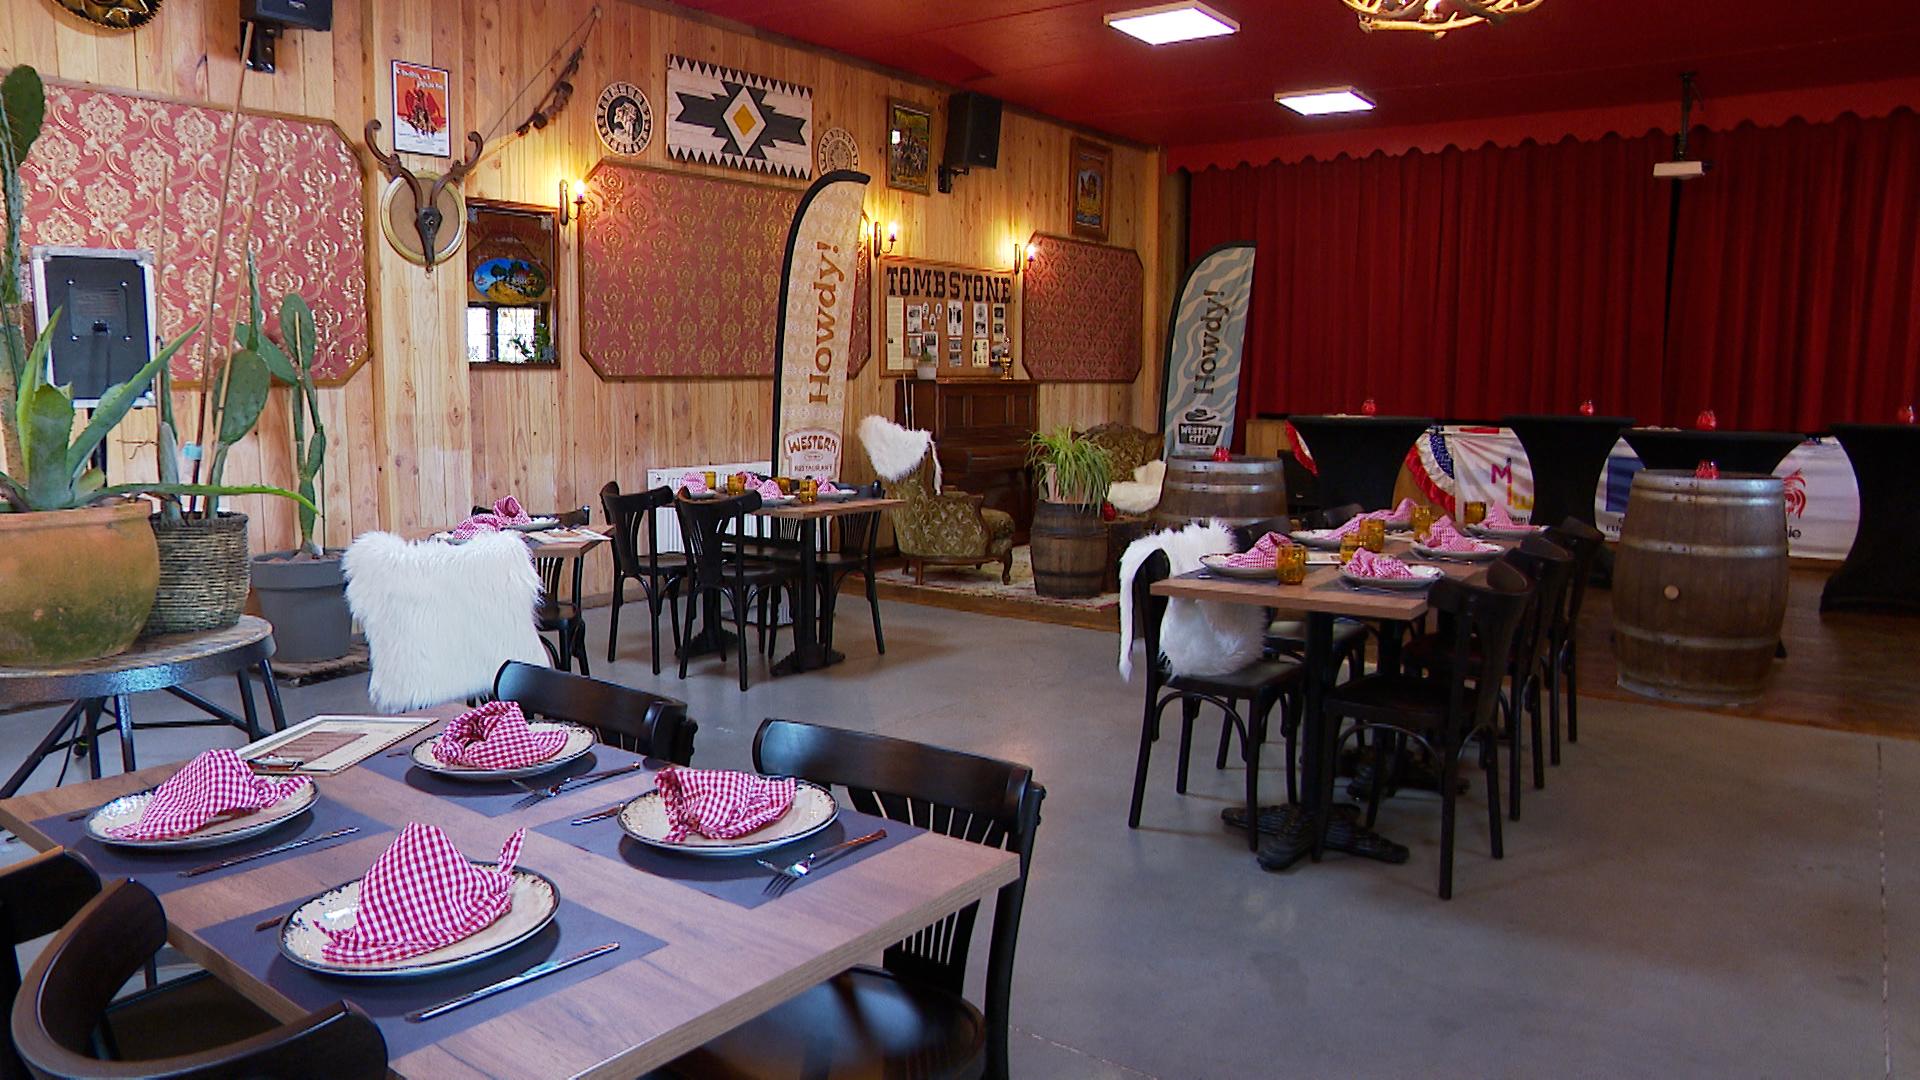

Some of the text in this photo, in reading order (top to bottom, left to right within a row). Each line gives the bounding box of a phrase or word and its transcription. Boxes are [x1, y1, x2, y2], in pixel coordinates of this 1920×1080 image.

[886, 266, 1011, 304] TOMBSTONE
[808, 241, 845, 404] Howdy!
[1193, 289, 1229, 395] Howdy!
[788, 435, 837, 454] WESTERN
